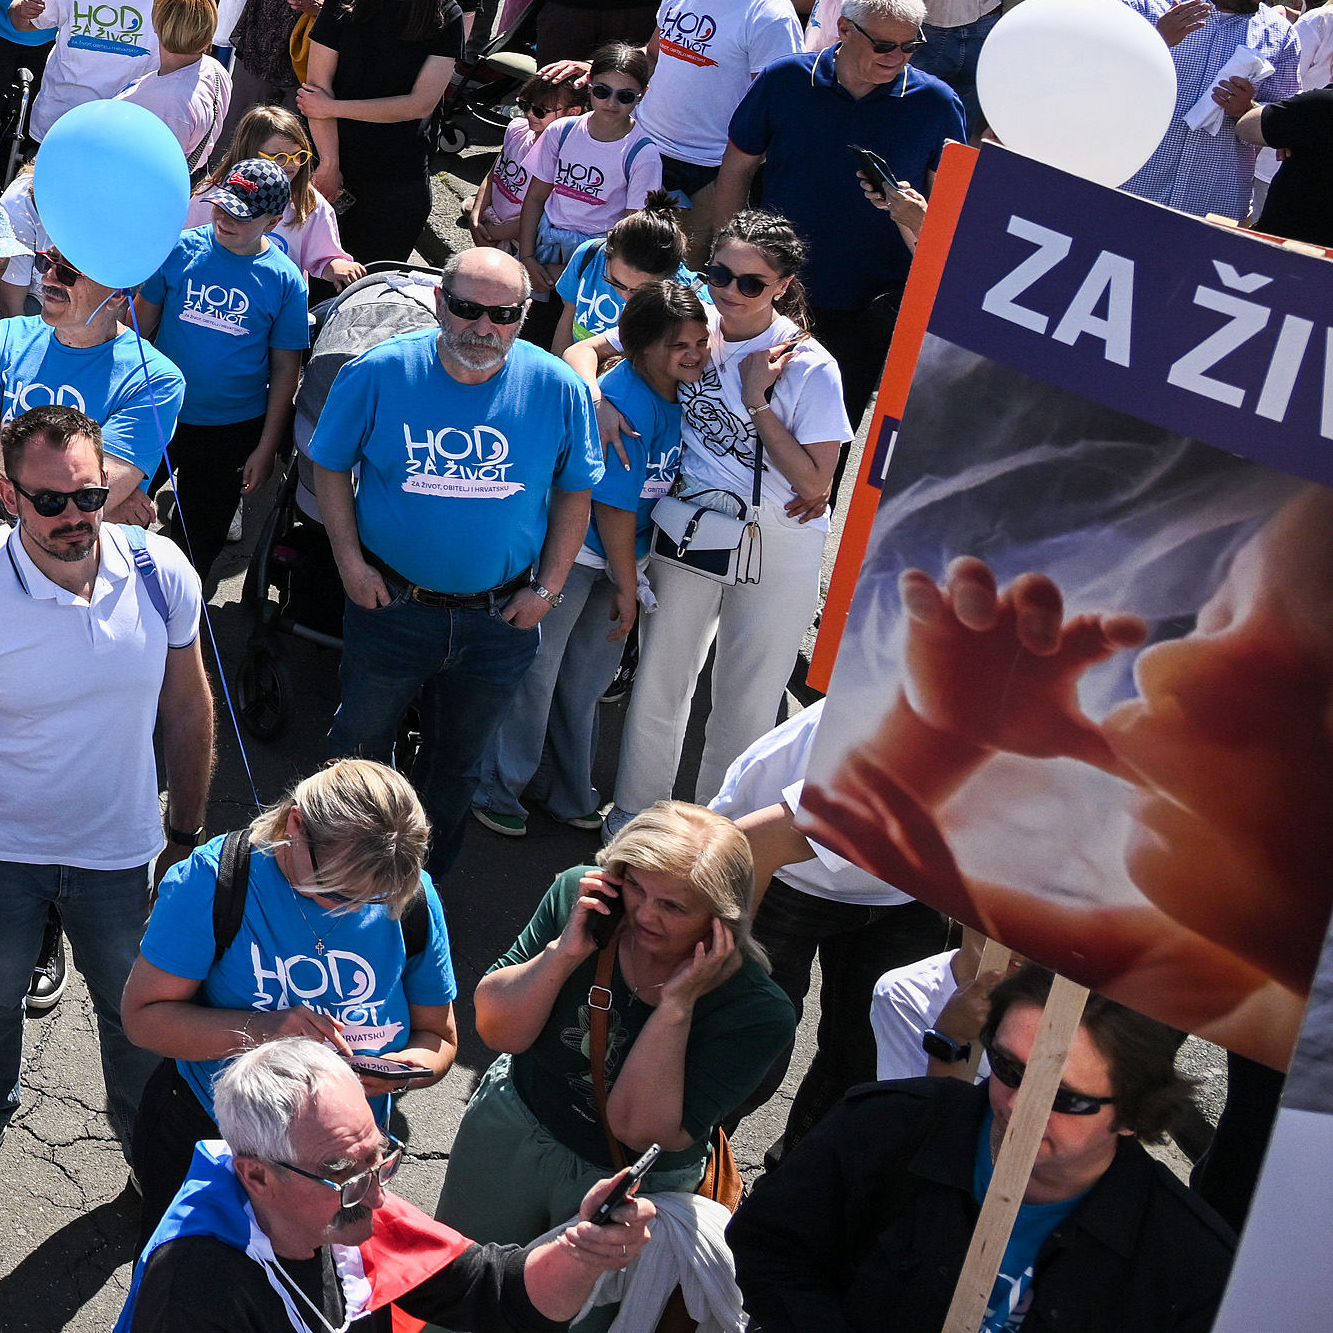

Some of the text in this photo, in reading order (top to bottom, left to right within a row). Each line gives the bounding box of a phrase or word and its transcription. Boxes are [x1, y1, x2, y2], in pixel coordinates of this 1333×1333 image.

[73, 0, 143, 33] HOD
[664, 6, 716, 41] HOD
[70, 23, 144, 46] ZA ŽIVOT
[186, 278, 248, 313] HOD
[981, 214, 1333, 441] ZA ŽI
[403, 422, 509, 467] HOD
[405, 455, 514, 482] ZA ŽIVOT
[421, 481, 442, 491] ŽIVOT,
